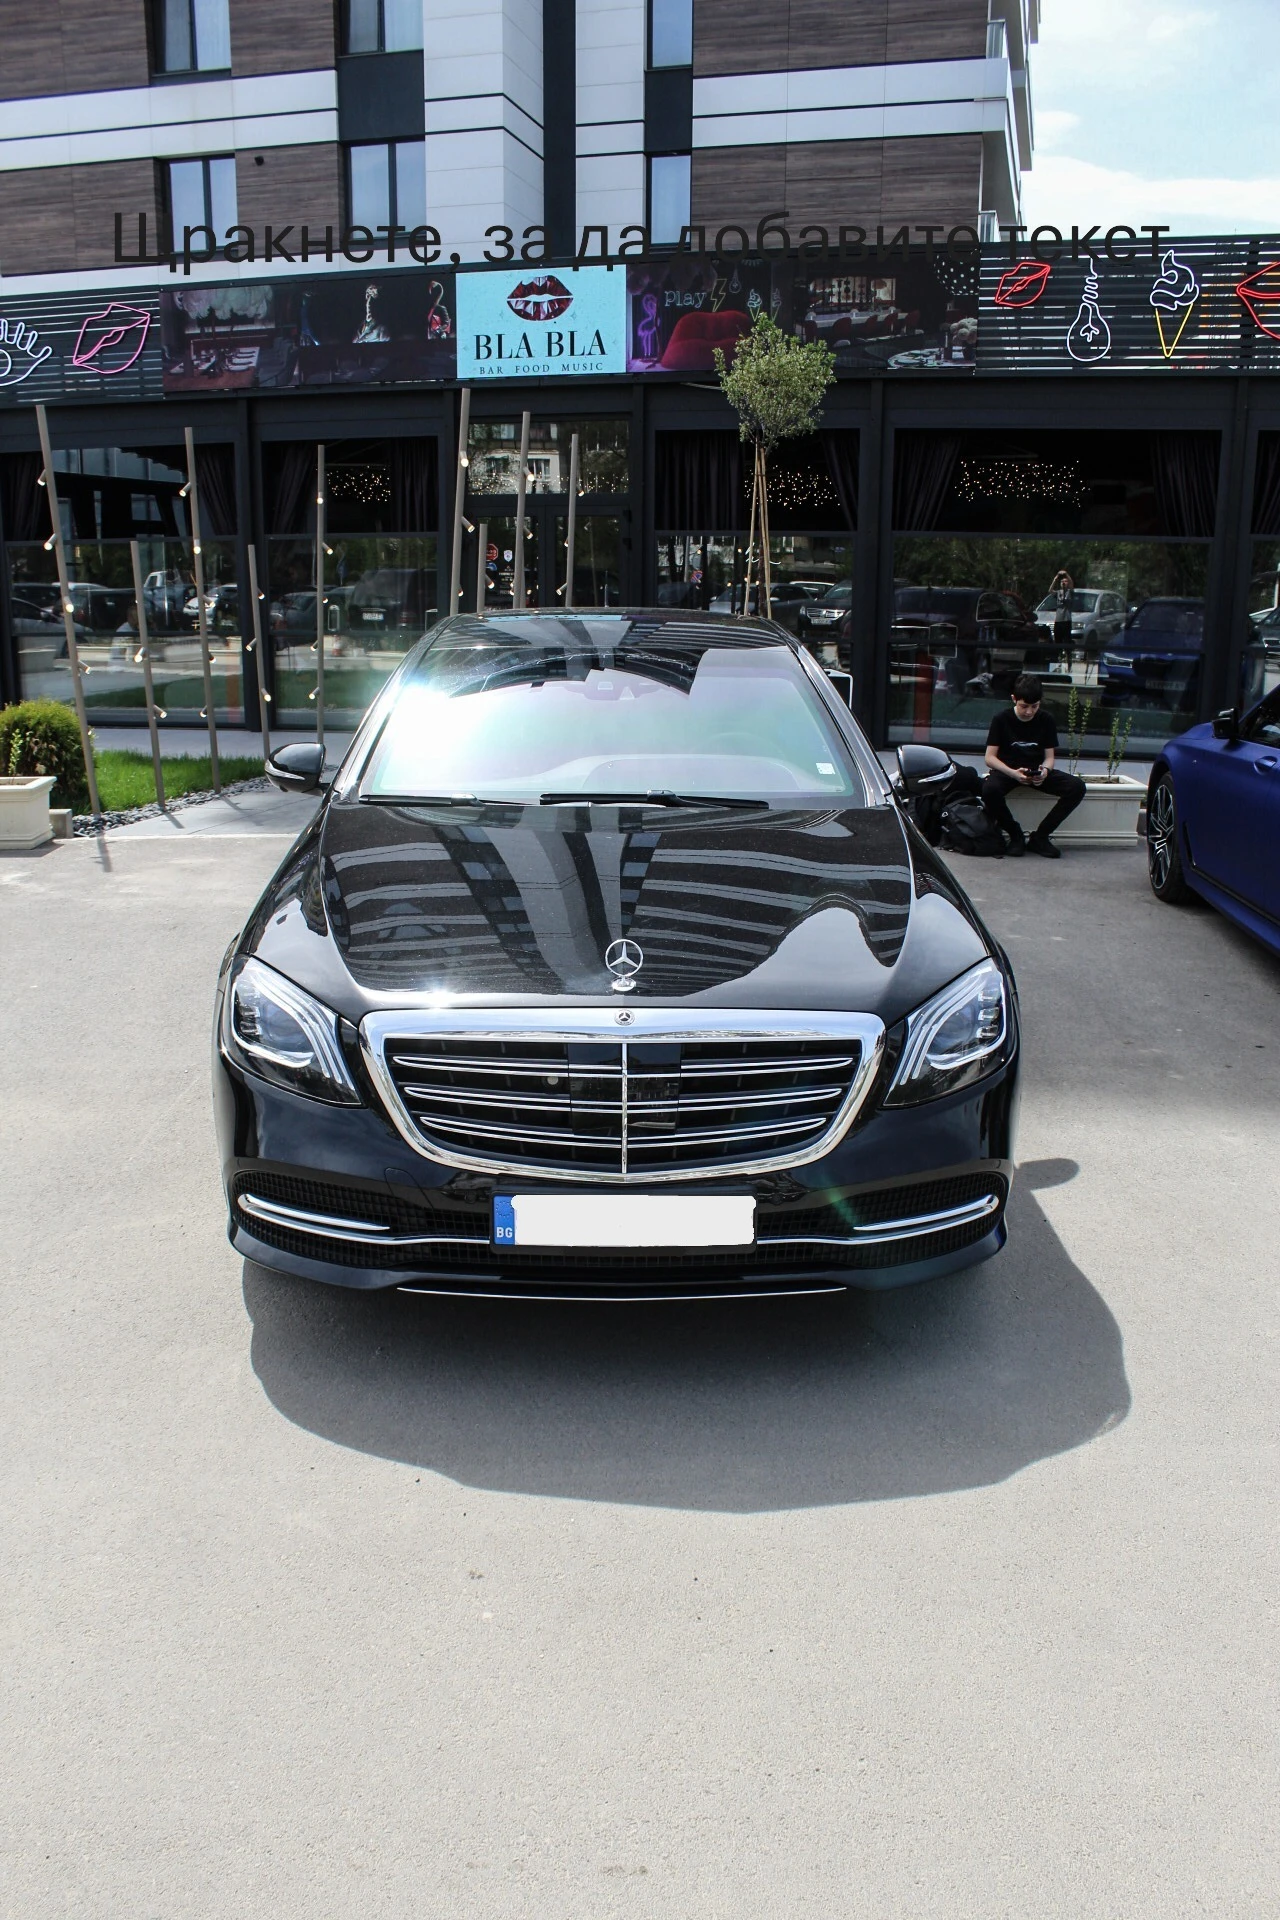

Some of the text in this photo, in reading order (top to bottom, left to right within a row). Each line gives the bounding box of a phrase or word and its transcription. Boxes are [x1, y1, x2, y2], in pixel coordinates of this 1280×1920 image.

[664, 290, 707, 309] play
[473, 328, 609, 361] BLA BLA
[479, 362, 604, 375] BAR FOOD MUSIC
[496, 1226, 513, 1239] BG
